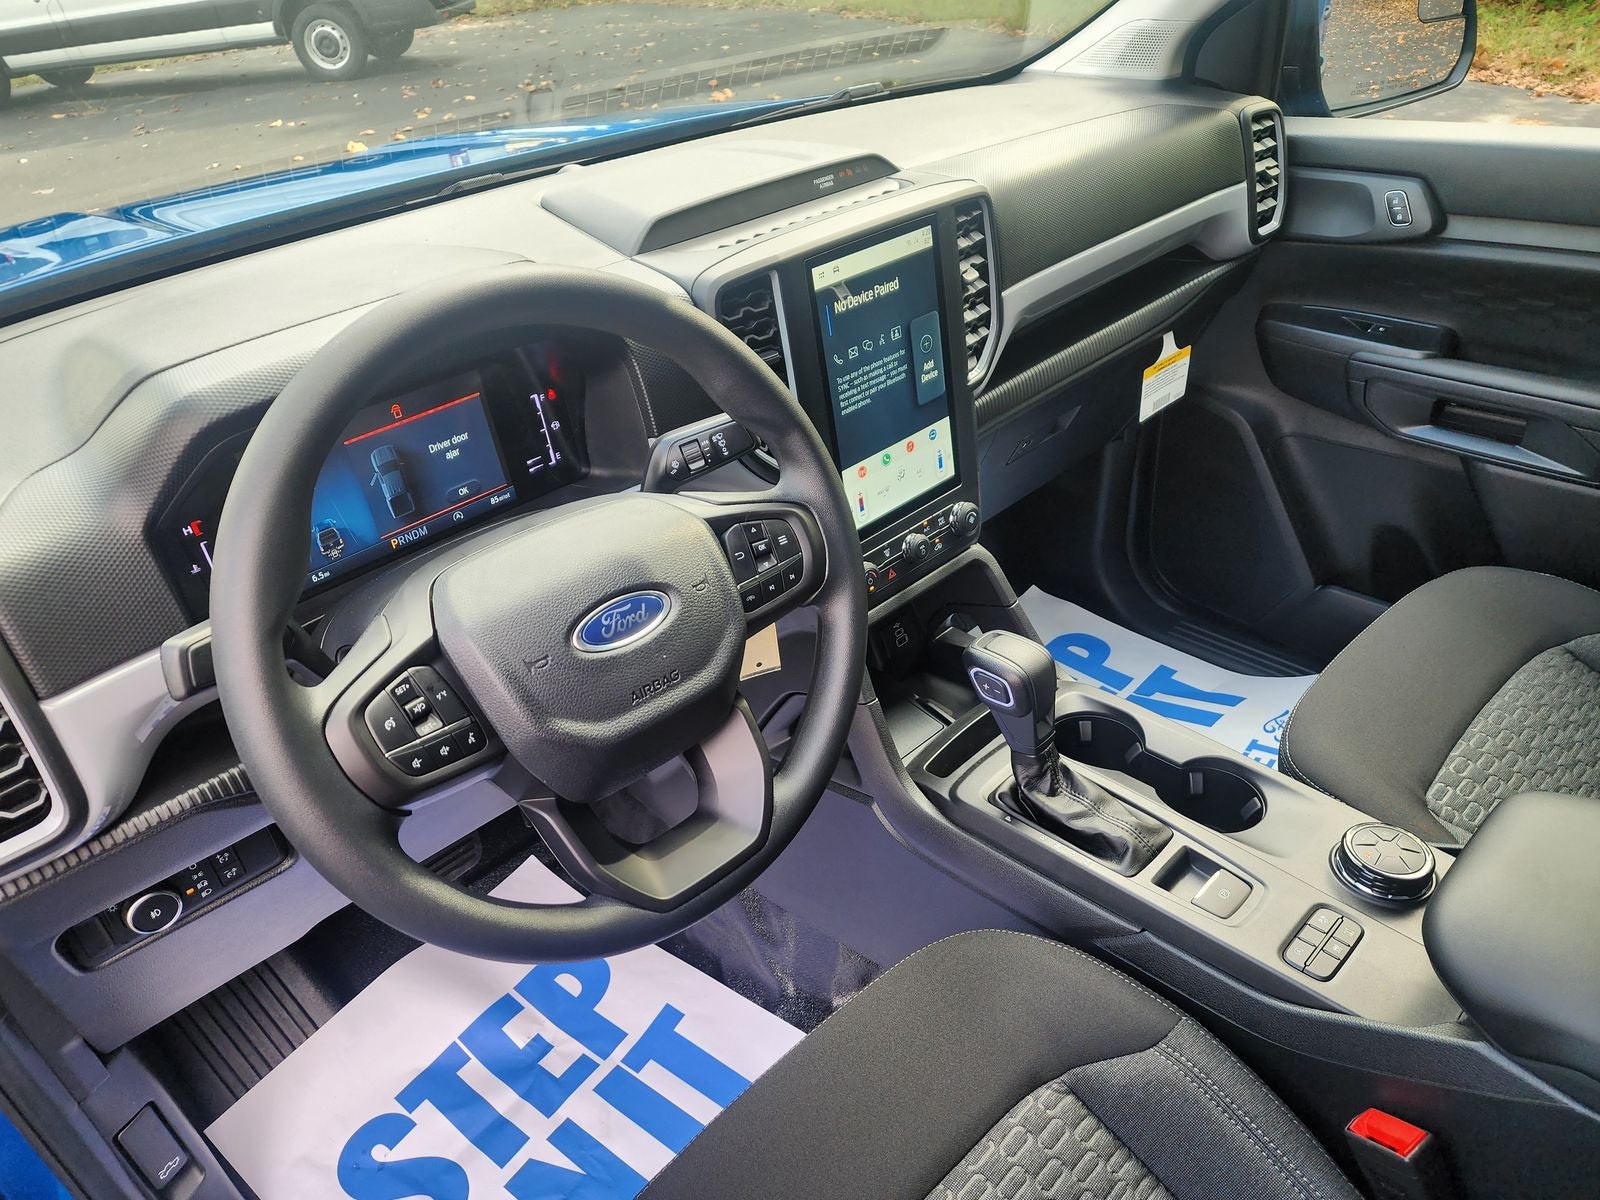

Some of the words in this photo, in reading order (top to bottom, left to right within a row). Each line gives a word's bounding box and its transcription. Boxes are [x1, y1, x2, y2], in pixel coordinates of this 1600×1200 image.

[834, 300, 847, 314] No
[847, 289, 874, 308] Device
[874, 277, 900, 298] Paired
[870, 359, 883, 370] phone
[883, 352, 900, 363] features
[923, 359, 934, 371] Add
[837, 382, 850, 392] SYNC
[868, 367, 884, 379] making
[868, 374, 887, 386] message
[921, 369, 938, 383] Device
[428, 438, 451, 454] Driver
[450, 431, 469, 449] door
[445, 446, 460, 461] ajar
[458, 486, 469, 496] OK
[182, 525, 194, 536] H
[758, 543, 767, 551] OK
[601, 602, 649, 639] Ford
[631, 669, 681, 706] AIRBAG
[336, 957, 629, 1200] STEP
